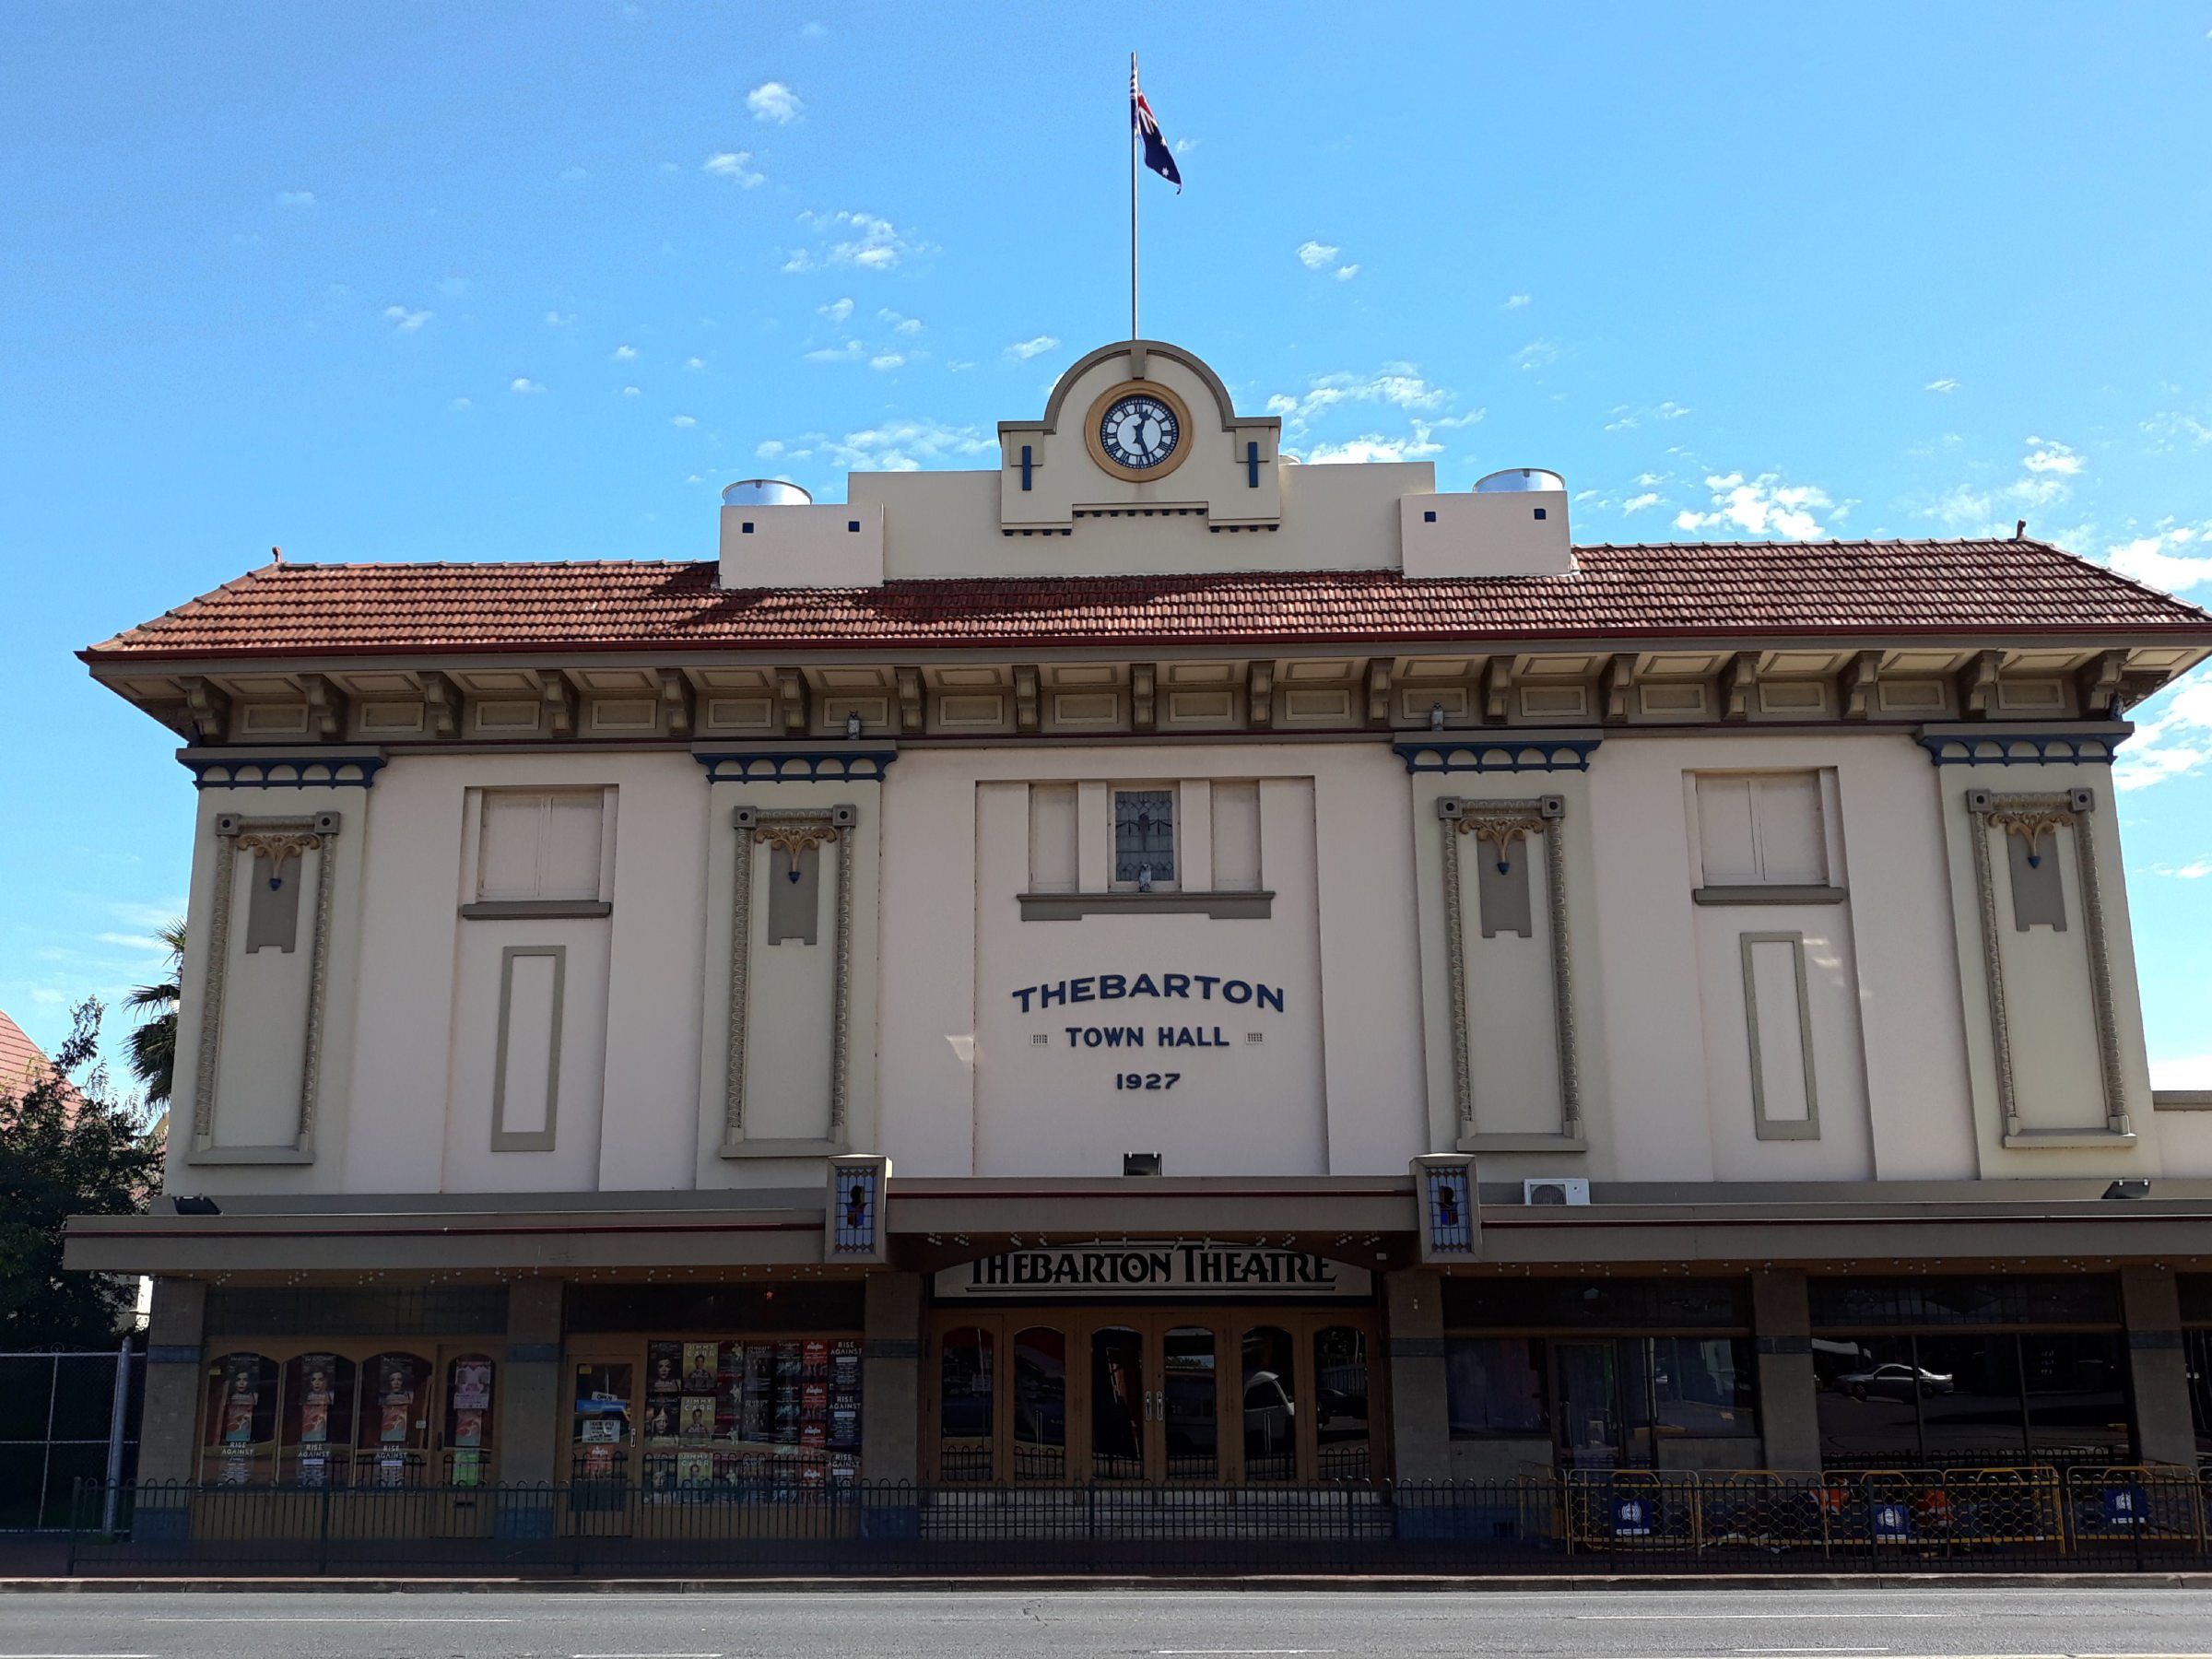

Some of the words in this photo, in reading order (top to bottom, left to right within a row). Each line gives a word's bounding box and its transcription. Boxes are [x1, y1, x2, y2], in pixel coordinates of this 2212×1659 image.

[1012, 973, 1284, 1013] THEBARTON
[1065, 1027, 1144, 1047] TOWN
[1158, 1027, 1230, 1047] HALL
[1116, 1073, 1181, 1090] 1927
[971, 1253, 1171, 1285] THEBARTON
[1171, 1244, 1337, 1284] THEATRE
